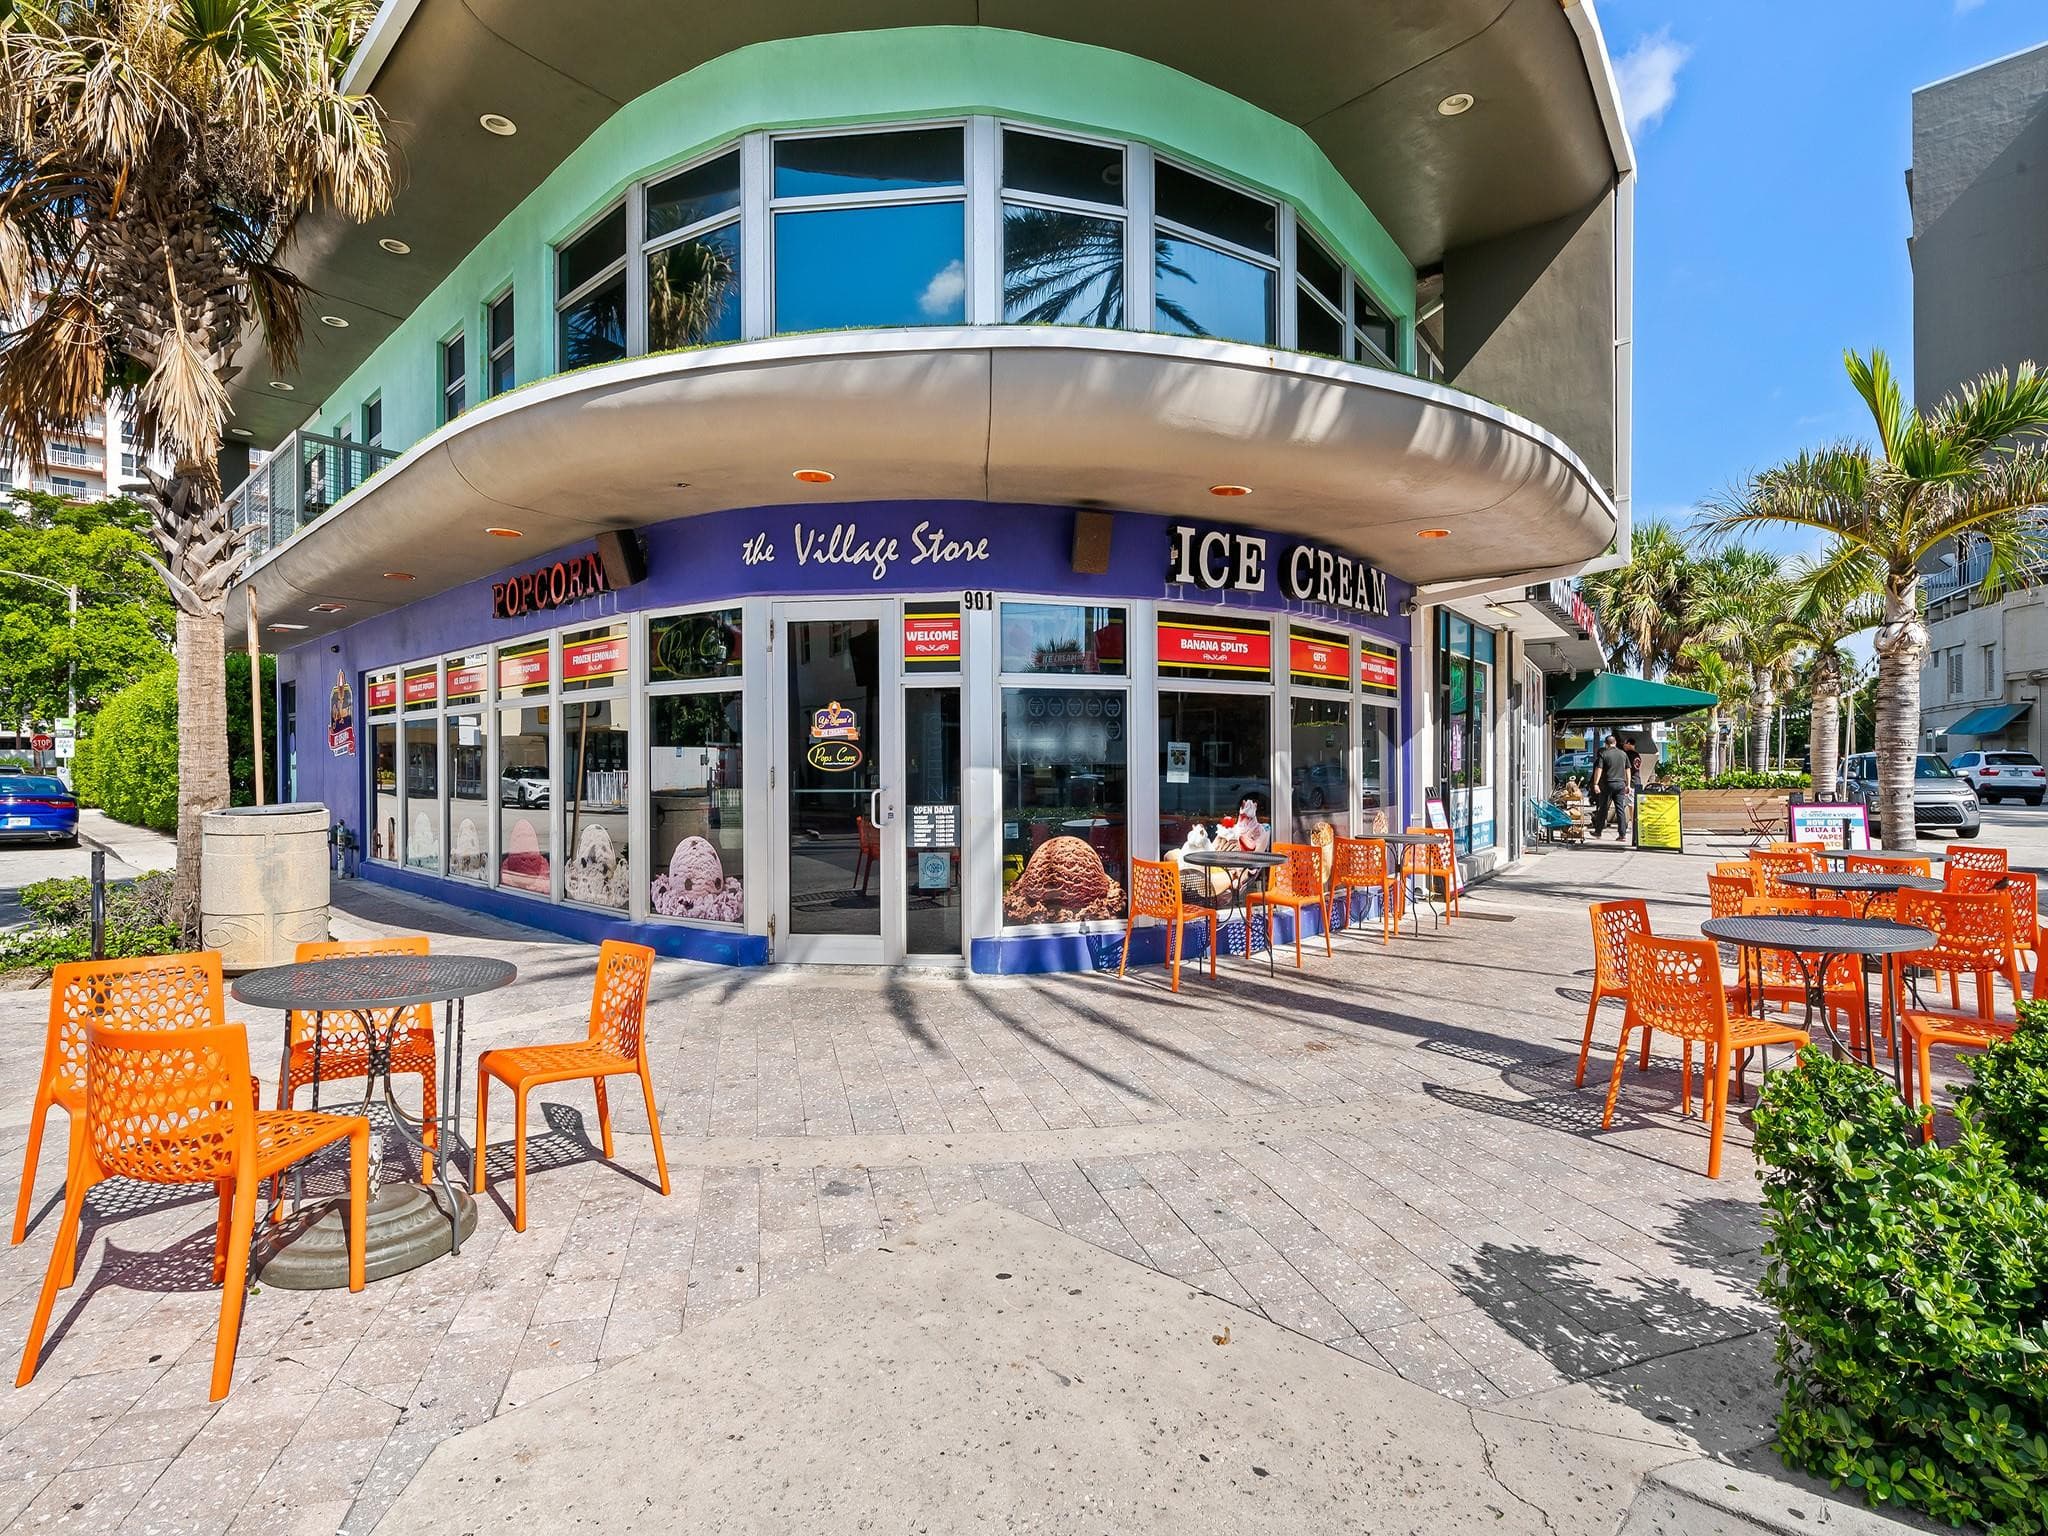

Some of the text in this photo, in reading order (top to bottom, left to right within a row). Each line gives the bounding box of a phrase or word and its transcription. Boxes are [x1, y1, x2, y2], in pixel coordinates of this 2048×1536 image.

[741, 521, 990, 581] the Village Store
[1176, 526, 1389, 617] ICE CREAM
[492, 552, 606, 619] POPCORN
[964, 591, 993, 611] 901
[906, 630, 959, 642] WELCOME
[1181, 639, 1249, 654] BANANA SPLITS
[591, 649, 620, 663] LEMONADE
[32, 739, 51, 747] STOP
[814, 746, 832, 765] Pops
[913, 805, 954, 815] OPEN DAILY
